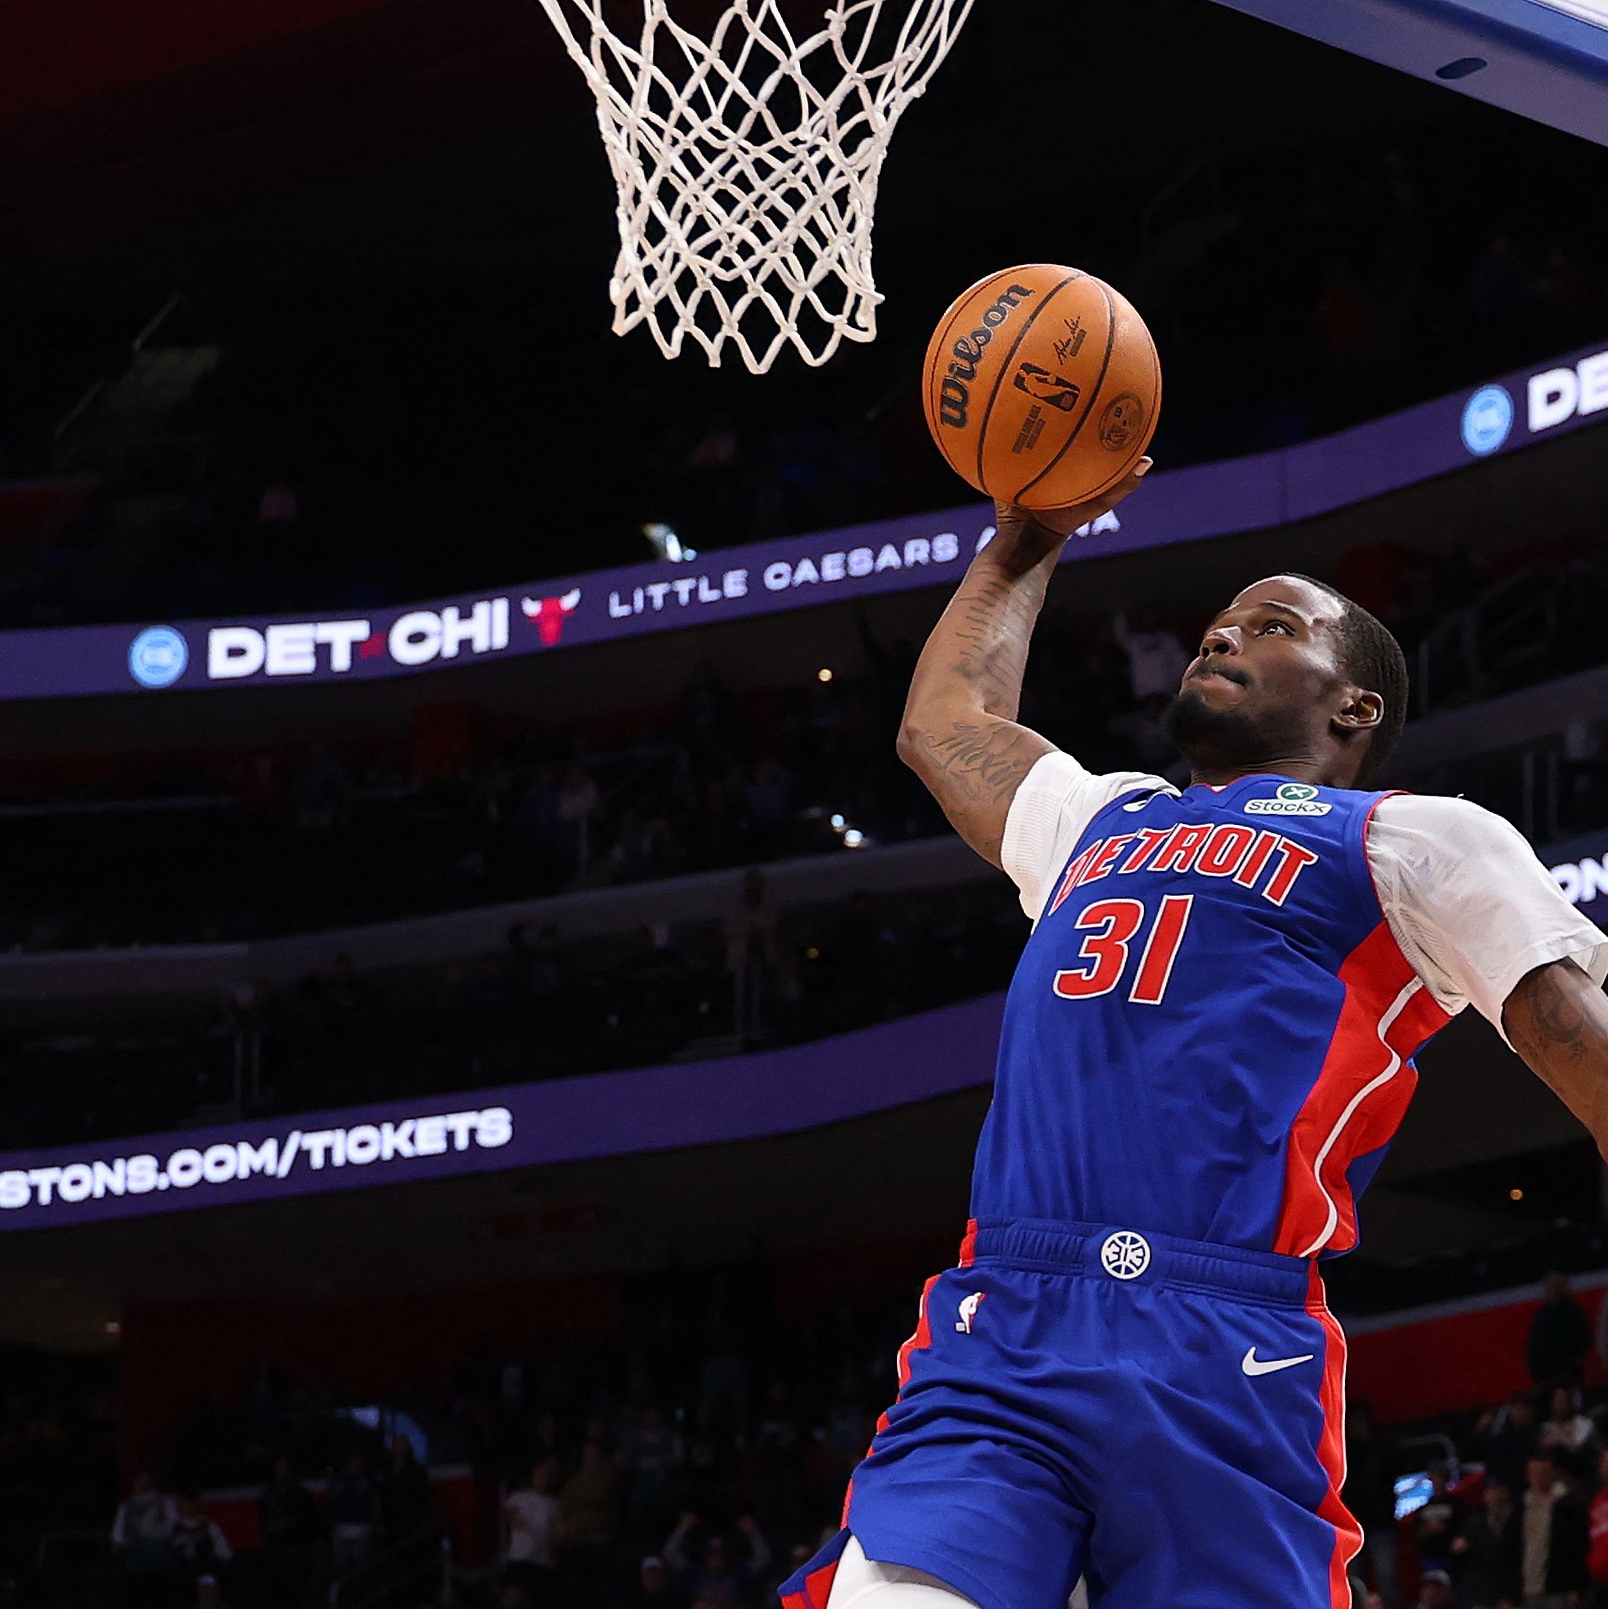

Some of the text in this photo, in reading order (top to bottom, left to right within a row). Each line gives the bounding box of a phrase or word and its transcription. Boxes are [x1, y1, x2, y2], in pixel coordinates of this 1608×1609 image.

[941, 284, 1035, 428] Wilson
[609, 533, 960, 618] LITTLE CAESARS
[207, 619, 370, 679] DET
[389, 598, 509, 665] CHI
[1048, 822, 1319, 916] DETROIT
[1052, 894, 1194, 1005] 31
